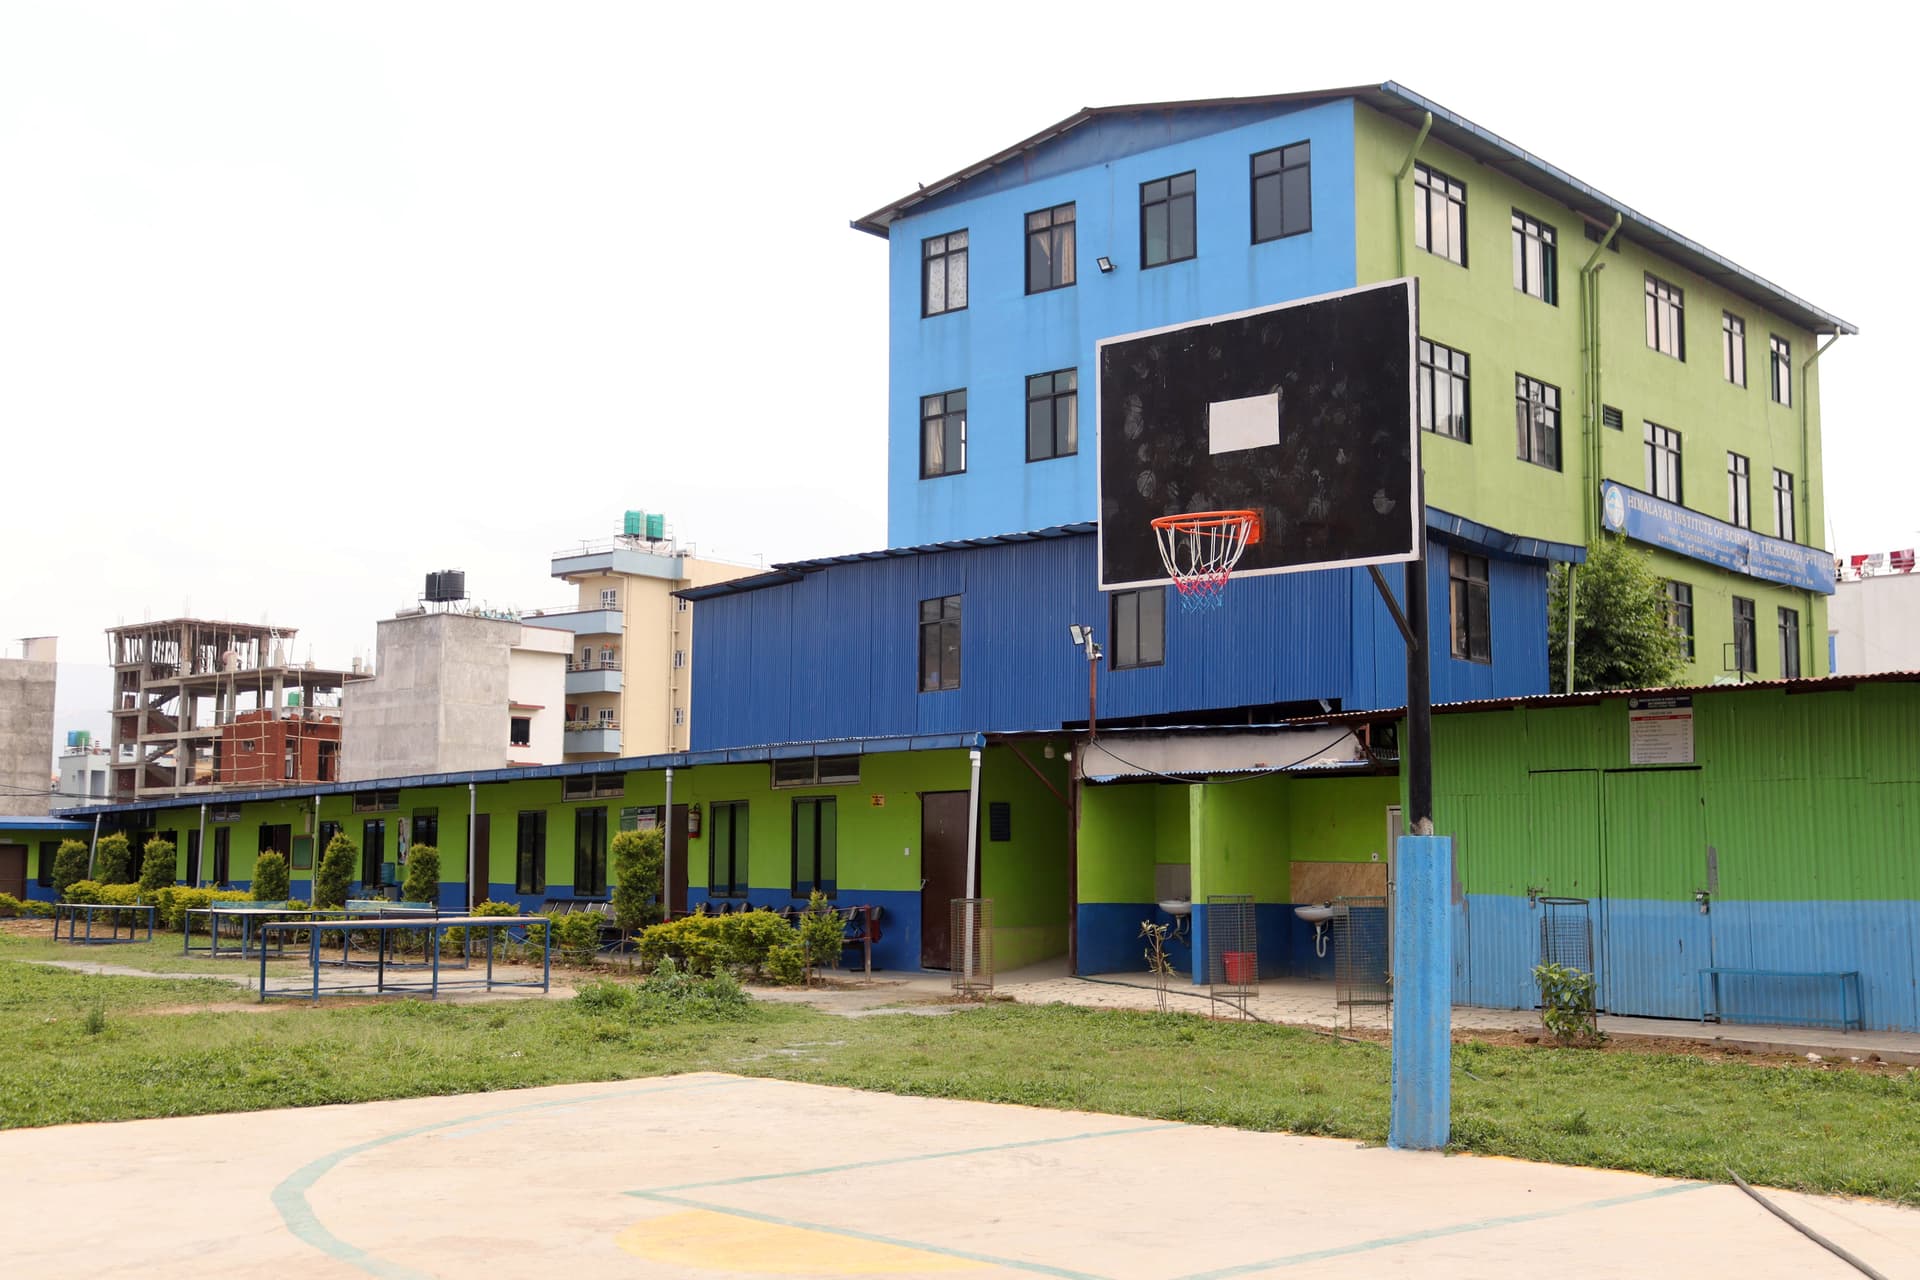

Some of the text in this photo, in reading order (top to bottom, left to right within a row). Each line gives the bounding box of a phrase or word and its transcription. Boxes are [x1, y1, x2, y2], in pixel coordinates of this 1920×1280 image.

[1628, 495, 1672, 521] HIMALAYAN
[1675, 511, 1712, 536] INSTITUTE
[1714, 526, 1723, 540] OF
